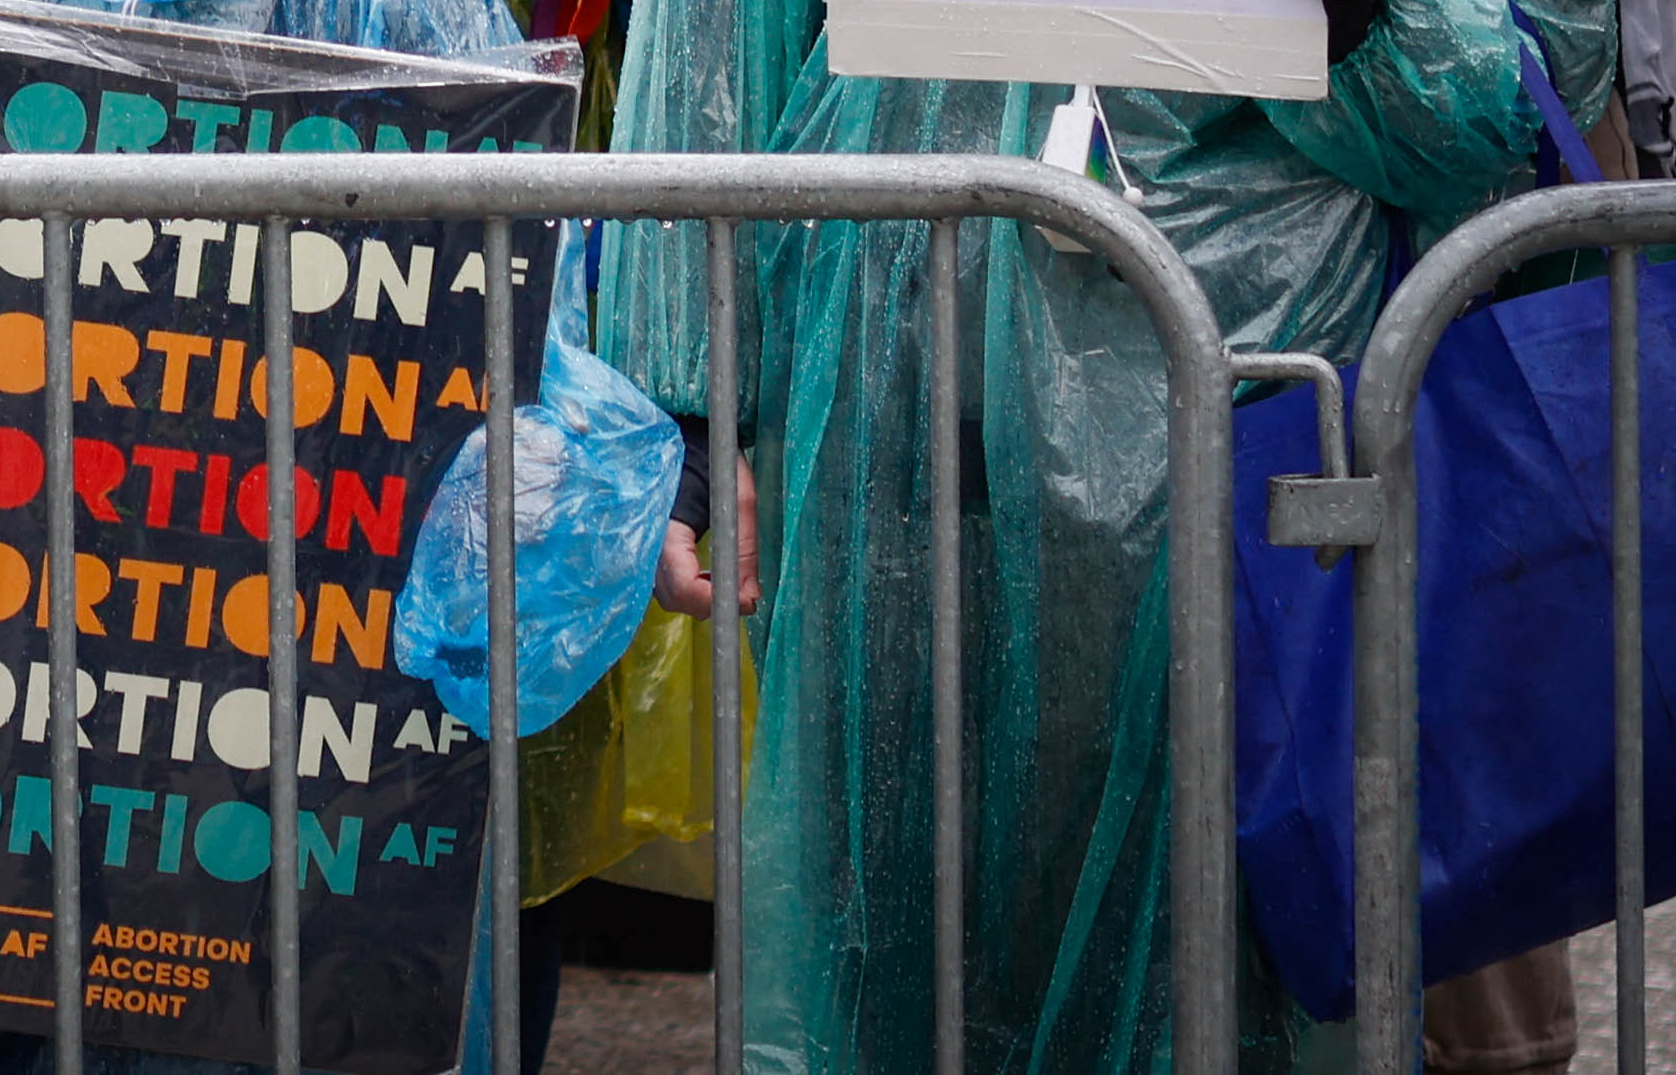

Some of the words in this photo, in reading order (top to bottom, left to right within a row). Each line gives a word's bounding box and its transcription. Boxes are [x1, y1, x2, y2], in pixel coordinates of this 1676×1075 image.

[435, 367, 491, 413] A
[392, 708, 469, 755] AF
[378, 822, 458, 868] AF
[91, 923, 252, 965] ABORTION
[88, 953, 211, 990] ACCESS
[84, 983, 187, 1019] FRONT
